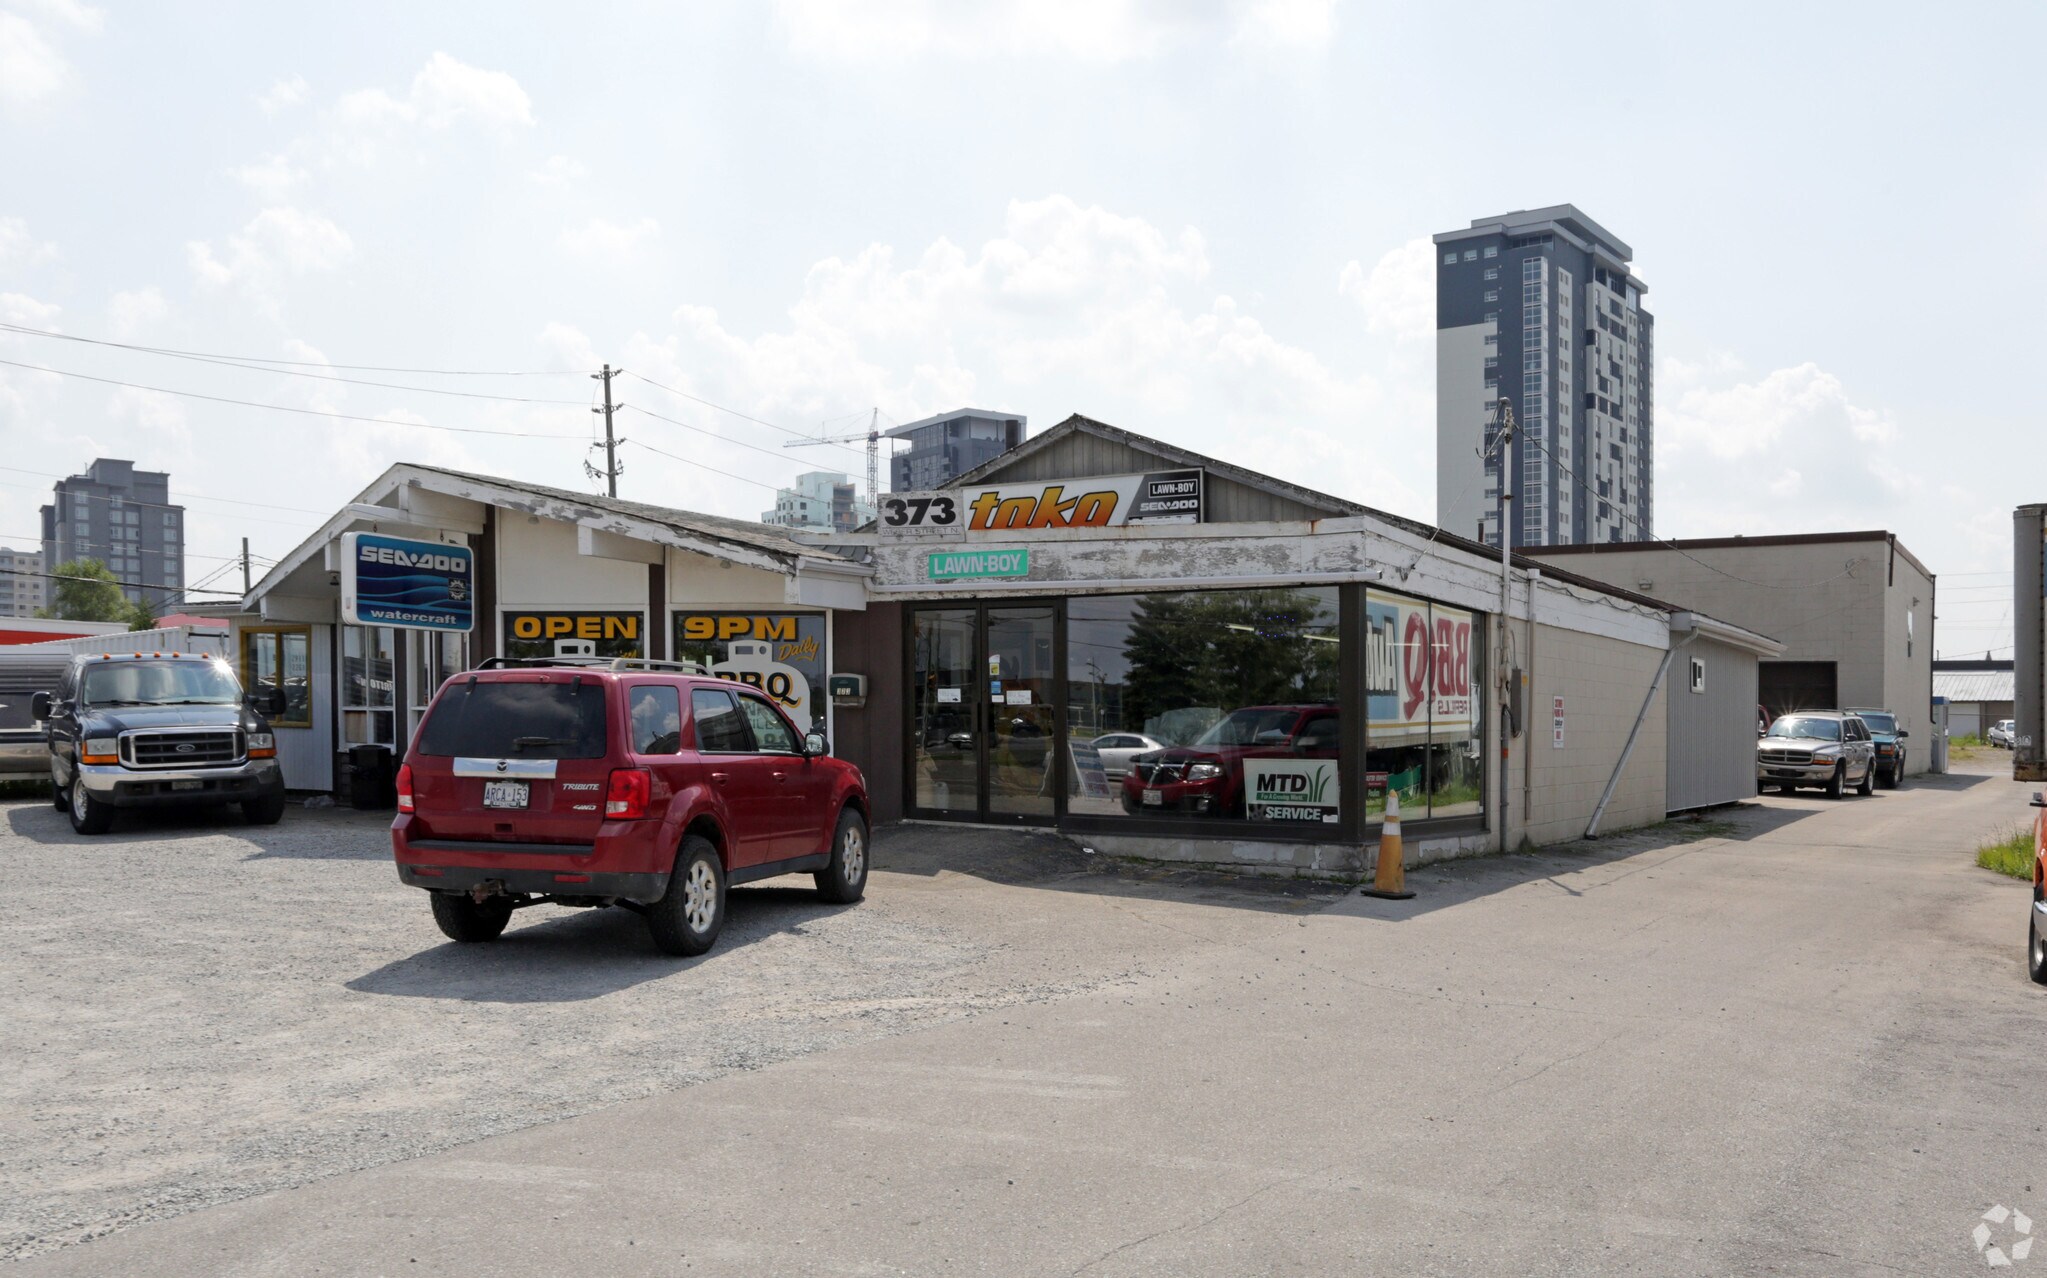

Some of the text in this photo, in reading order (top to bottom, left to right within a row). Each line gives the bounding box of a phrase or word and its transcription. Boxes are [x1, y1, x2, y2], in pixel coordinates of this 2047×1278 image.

[1152, 482, 1195, 495] LAWN-BOY
[884, 497, 957, 527] 373
[915, 527, 947, 535] STREET
[933, 553, 1022, 575] LAWN-BOY
[370, 609, 457, 625] watercraft
[514, 616, 638, 640] OPEN
[684, 616, 798, 641] 9PM
[778, 635, 821, 662] Daily
[562, 783, 600, 791] TRIBUTE
[1256, 773, 1307, 792] MTD
[485, 787, 528, 802] ARCA 153
[1265, 806, 1322, 820] SERVICE
